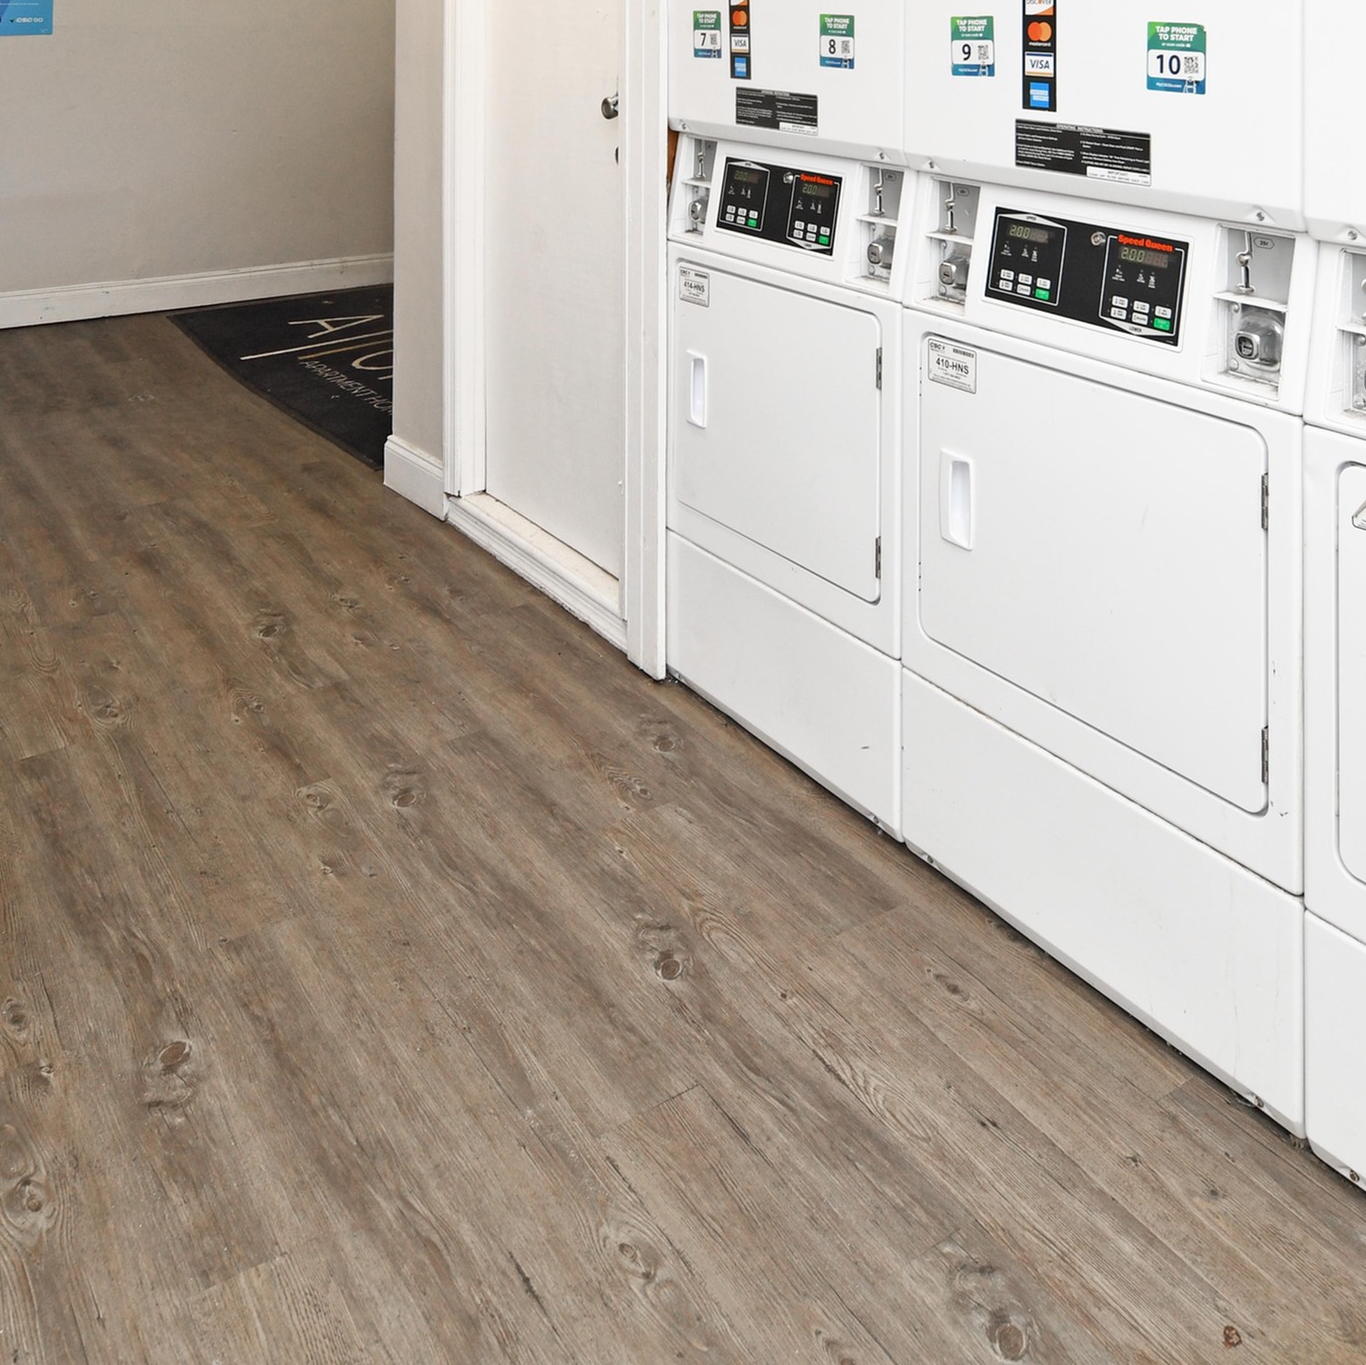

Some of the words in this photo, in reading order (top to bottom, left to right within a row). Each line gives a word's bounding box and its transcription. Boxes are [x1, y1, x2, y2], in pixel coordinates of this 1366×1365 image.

[1155, 25, 1170, 33] TAP
[1170, 26, 1198, 35] PHONE
[700, 32, 707, 46] 7
[734, 39, 747, 48] VISA
[1170, 34, 1195, 42] START
[828, 38, 836, 55] 8
[961, 43, 972, 61] 9
[1030, 59, 1050, 70] VISA
[1156, 53, 1181, 75] 10
[1118, 234, 1145, 246] Speed
[1145, 239, 1173, 252] Queen
[1129, 325, 1142, 333] LOWER
[936, 357, 970, 375] 410-HNS
[299, 360, 376, 400] APARTMENT
